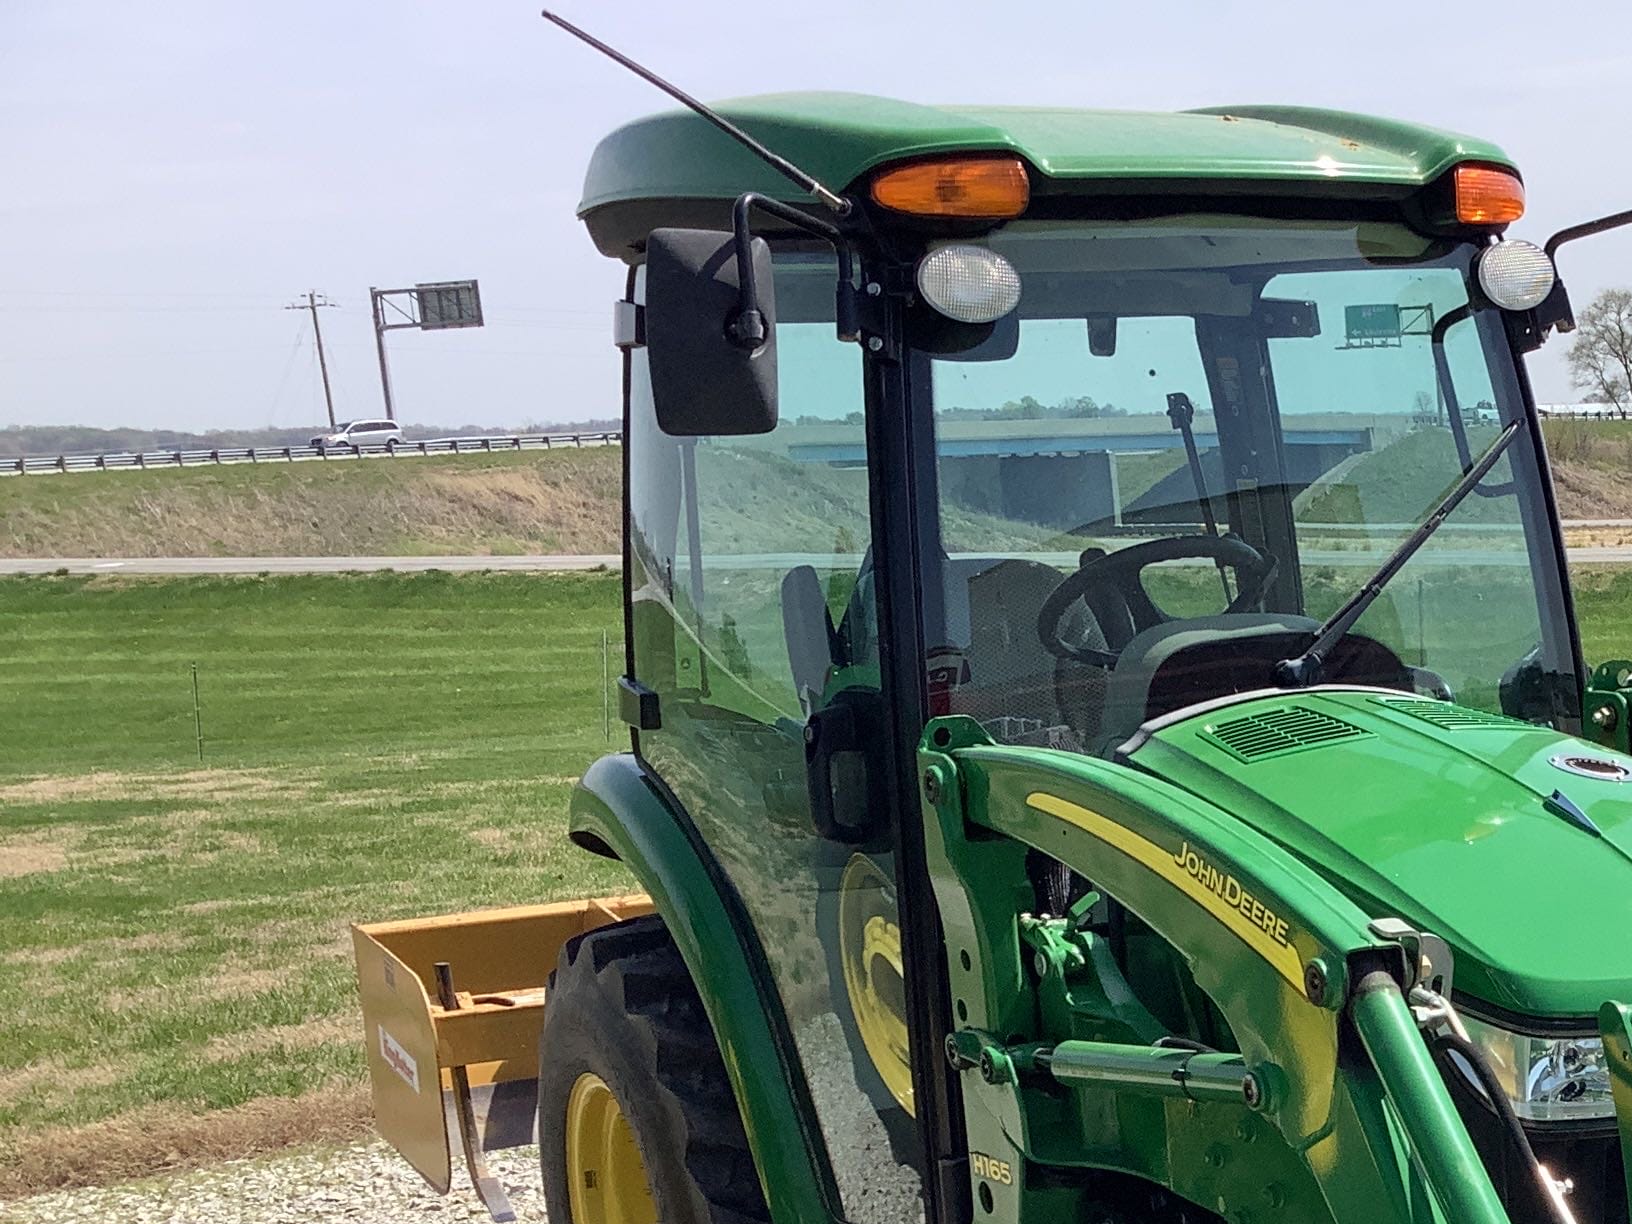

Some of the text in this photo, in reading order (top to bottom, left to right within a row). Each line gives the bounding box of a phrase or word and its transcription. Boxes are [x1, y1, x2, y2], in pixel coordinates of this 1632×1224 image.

[1173, 841, 1289, 946] JOHN DEERE
[973, 1153, 1012, 1185] H165
